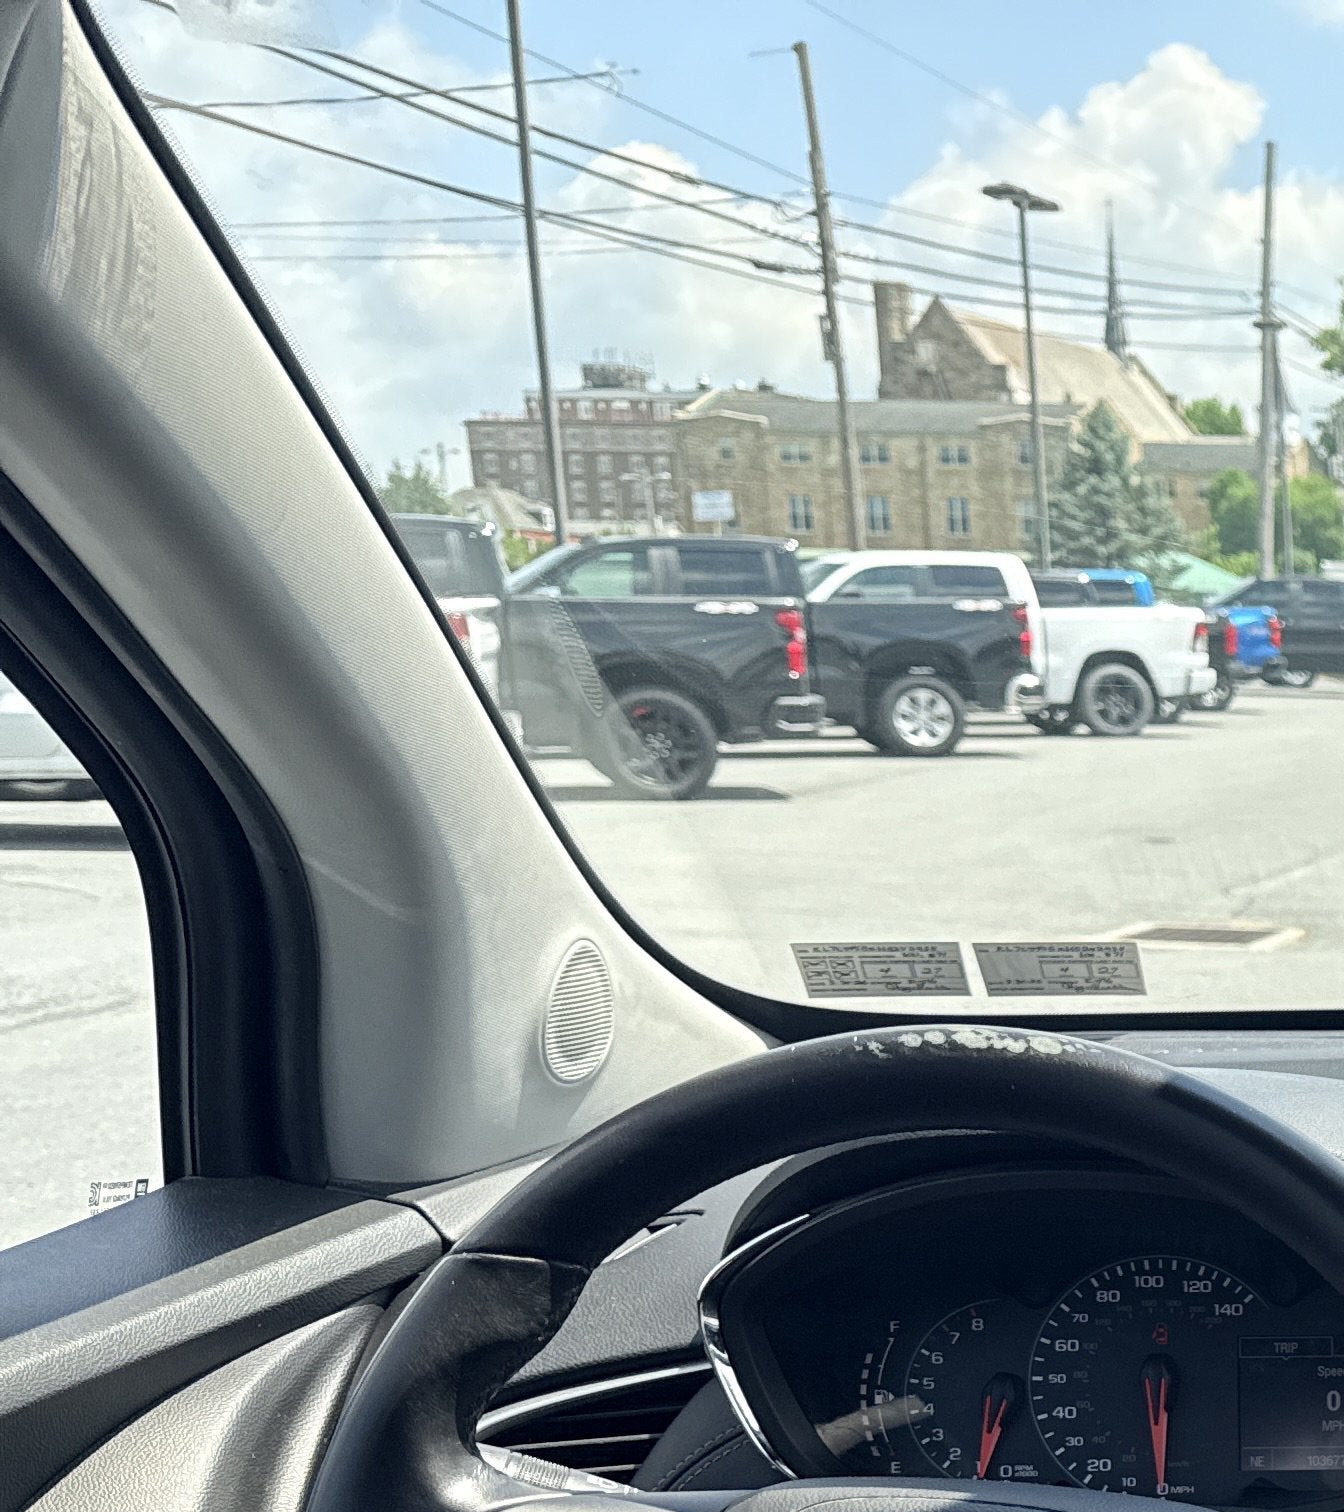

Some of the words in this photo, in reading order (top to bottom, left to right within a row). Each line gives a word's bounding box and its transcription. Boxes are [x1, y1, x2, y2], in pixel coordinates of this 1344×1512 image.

[1134, 1276, 1164, 1288] 100
[1183, 1281, 1212, 1293] 120
[1096, 1290, 1121, 1302] 80
[1213, 1304, 1243, 1316] 140
[971, 1318, 984, 1331] 8
[1072, 1314, 1089, 1323] 70
[890, 1321, 900, 1332] F
[949, 1332, 960, 1345] 7
[1055, 1339, 1079, 1352] 60
[1274, 1342, 1299, 1354] TRIP
[931, 1352, 944, 1365] 6
[922, 1377, 935, 1389] 5
[1048, 1374, 1066, 1383] 50
[1326, 1390, 1341, 1411] 0
[923, 1403, 935, 1415] 4
[1052, 1406, 1077, 1419] 40
[932, 1429, 944, 1441] 3
[1065, 1437, 1084, 1446] 30
[949, 1448, 961, 1461] 2
[890, 1461, 901, 1474] E
[1087, 1459, 1111, 1472] 20
[1250, 1456, 1265, 1467] NE
[1000, 1465, 1012, 1478] 0
[1121, 1477, 1137, 1487] 10
[1156, 1482, 1169, 1495] 0
[1170, 1485, 1194, 1494] MPH
